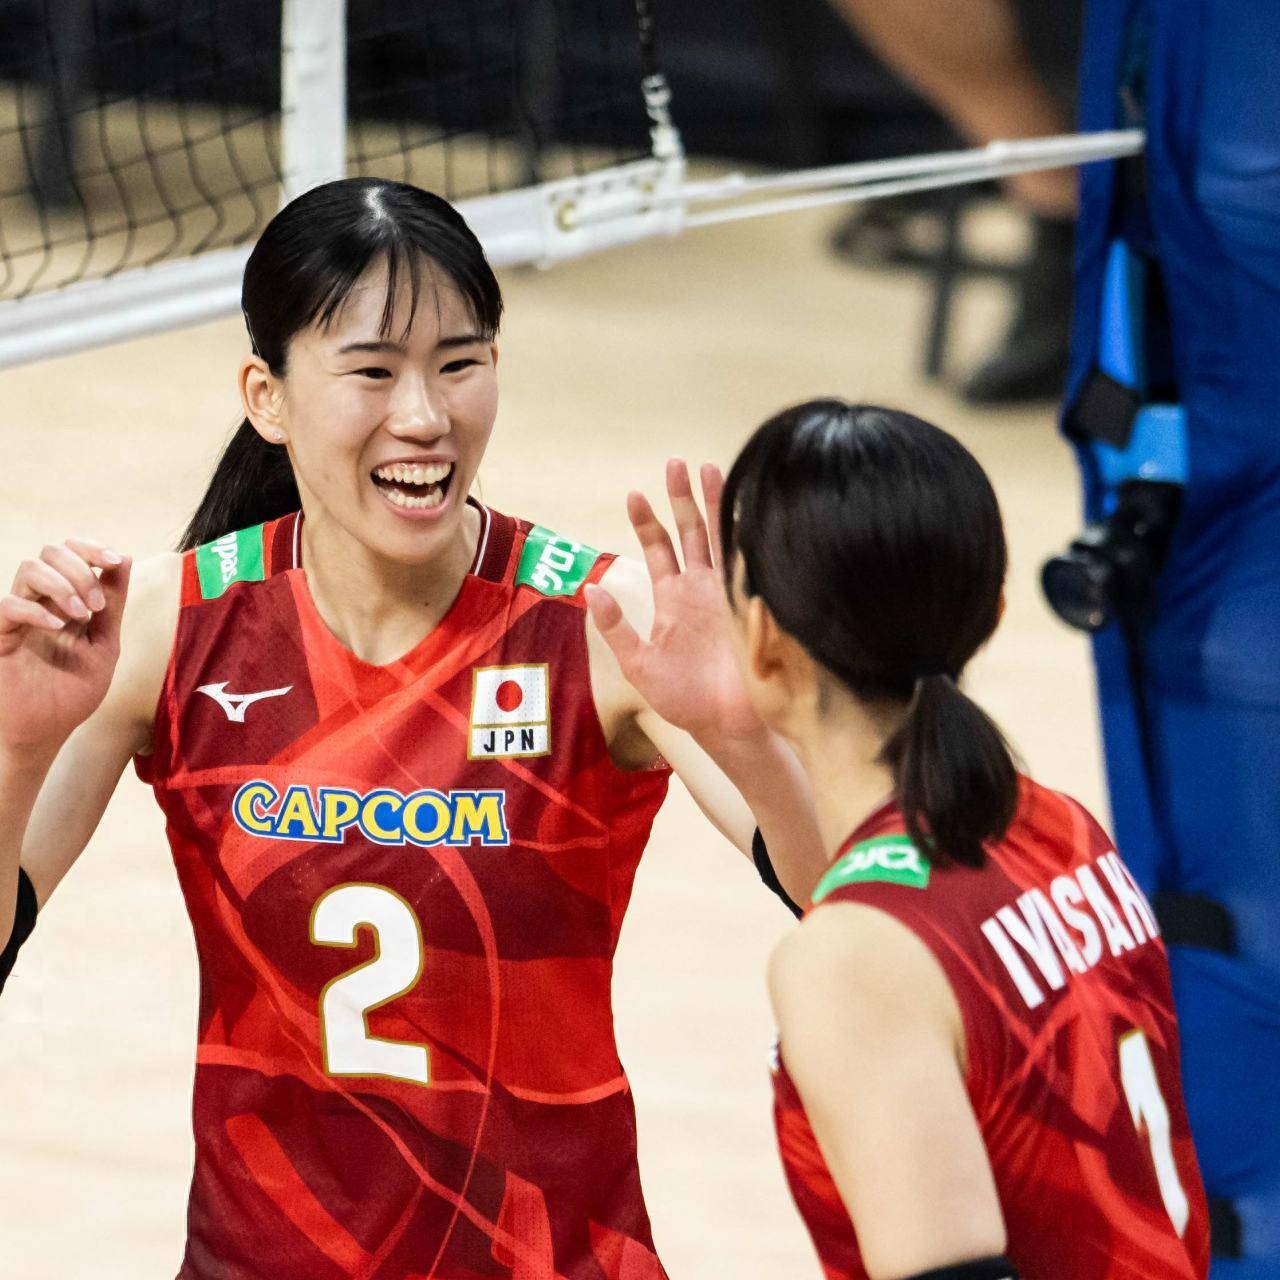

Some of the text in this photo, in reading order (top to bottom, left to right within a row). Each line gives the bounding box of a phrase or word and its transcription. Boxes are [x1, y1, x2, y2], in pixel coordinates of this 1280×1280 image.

[483, 729, 535, 752] JPN
[233, 780, 510, 846] CAPCOM
[309, 882, 430, 1087] 2
